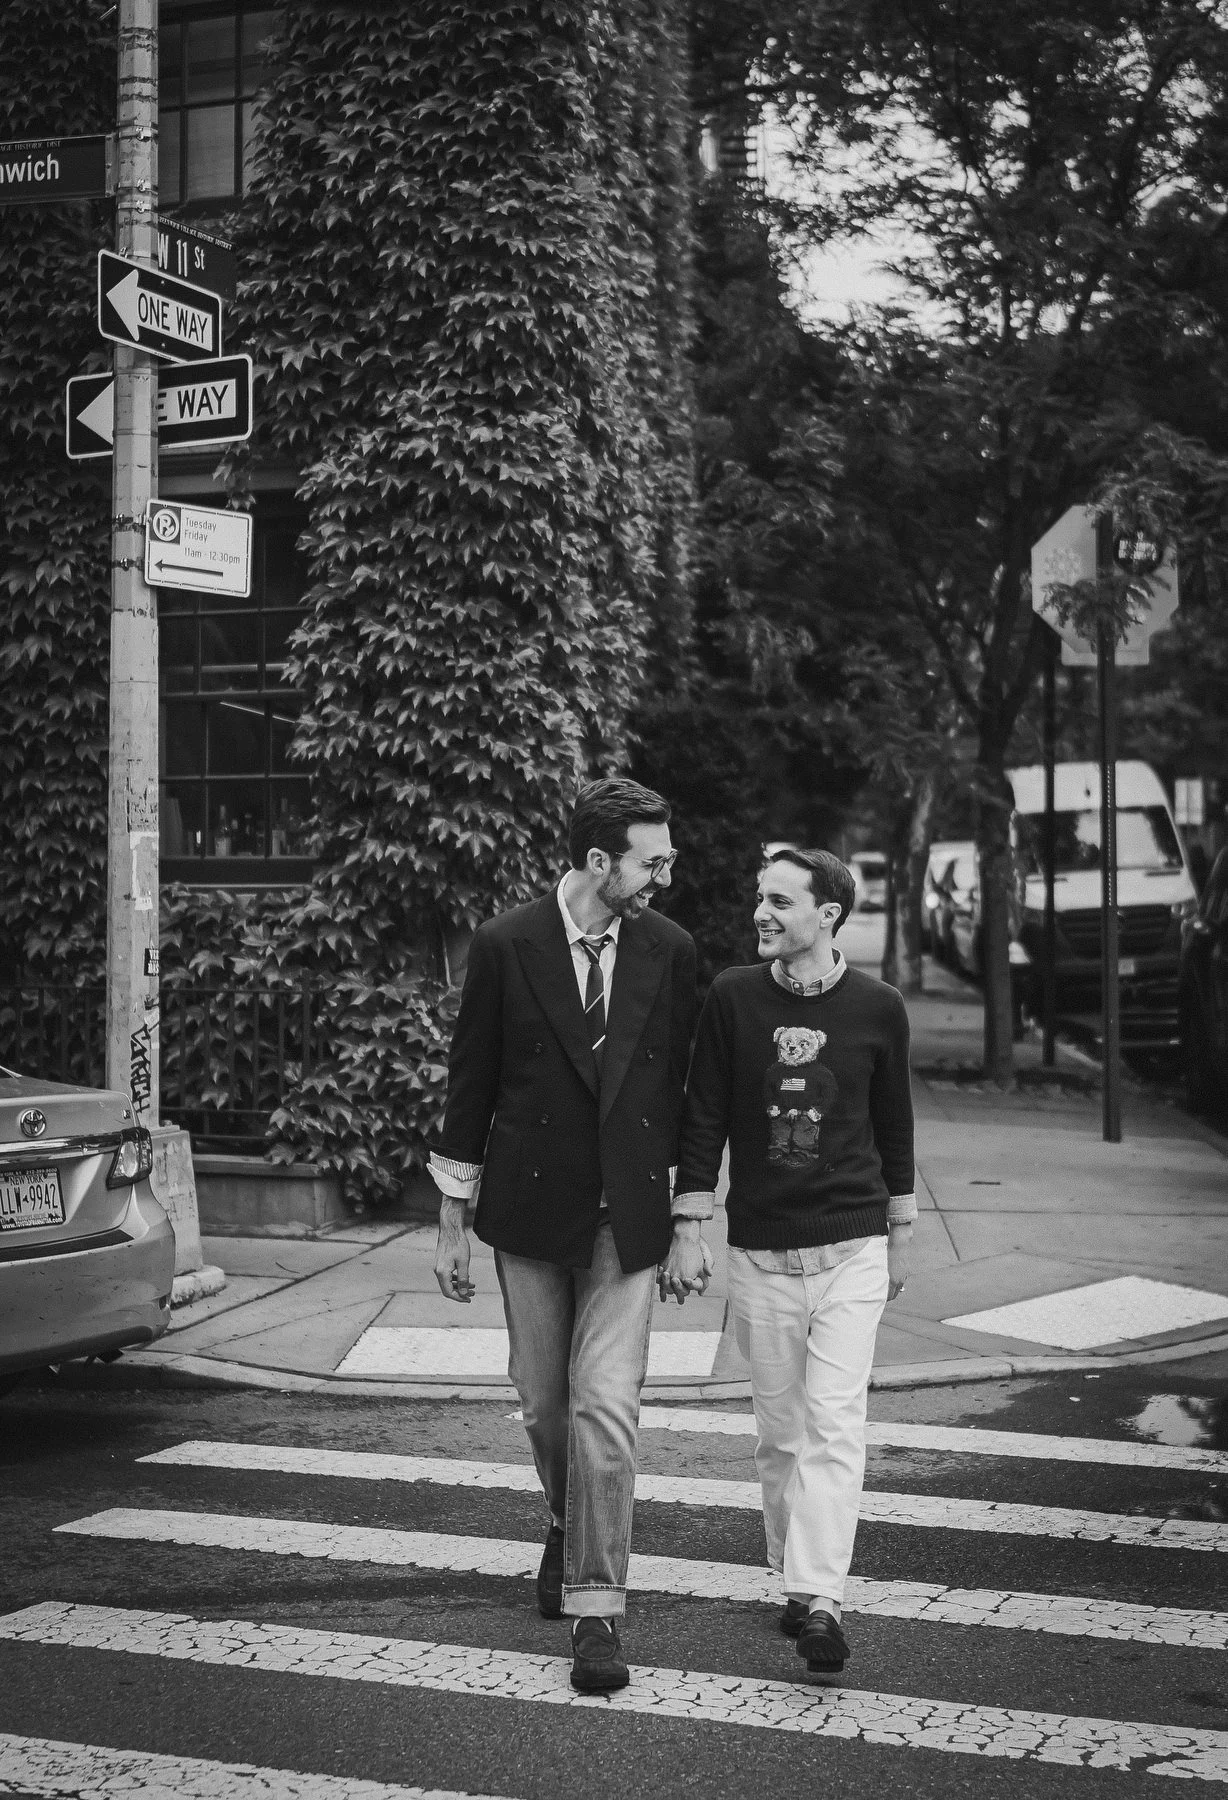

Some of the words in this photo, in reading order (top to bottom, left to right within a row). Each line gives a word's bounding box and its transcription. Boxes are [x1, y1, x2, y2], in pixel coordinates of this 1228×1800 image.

[158, 232, 169, 270] W
[176, 239, 188, 277] 11
[194, 245, 205, 271] St
[138, 292, 170, 332] ONE
[176, 306, 208, 344] WAY
[177, 384, 229, 419] WAY
[184, 528, 208, 543] Friday
[185, 517, 217, 533] Tuesday
[184, 547, 202, 558] 11am
